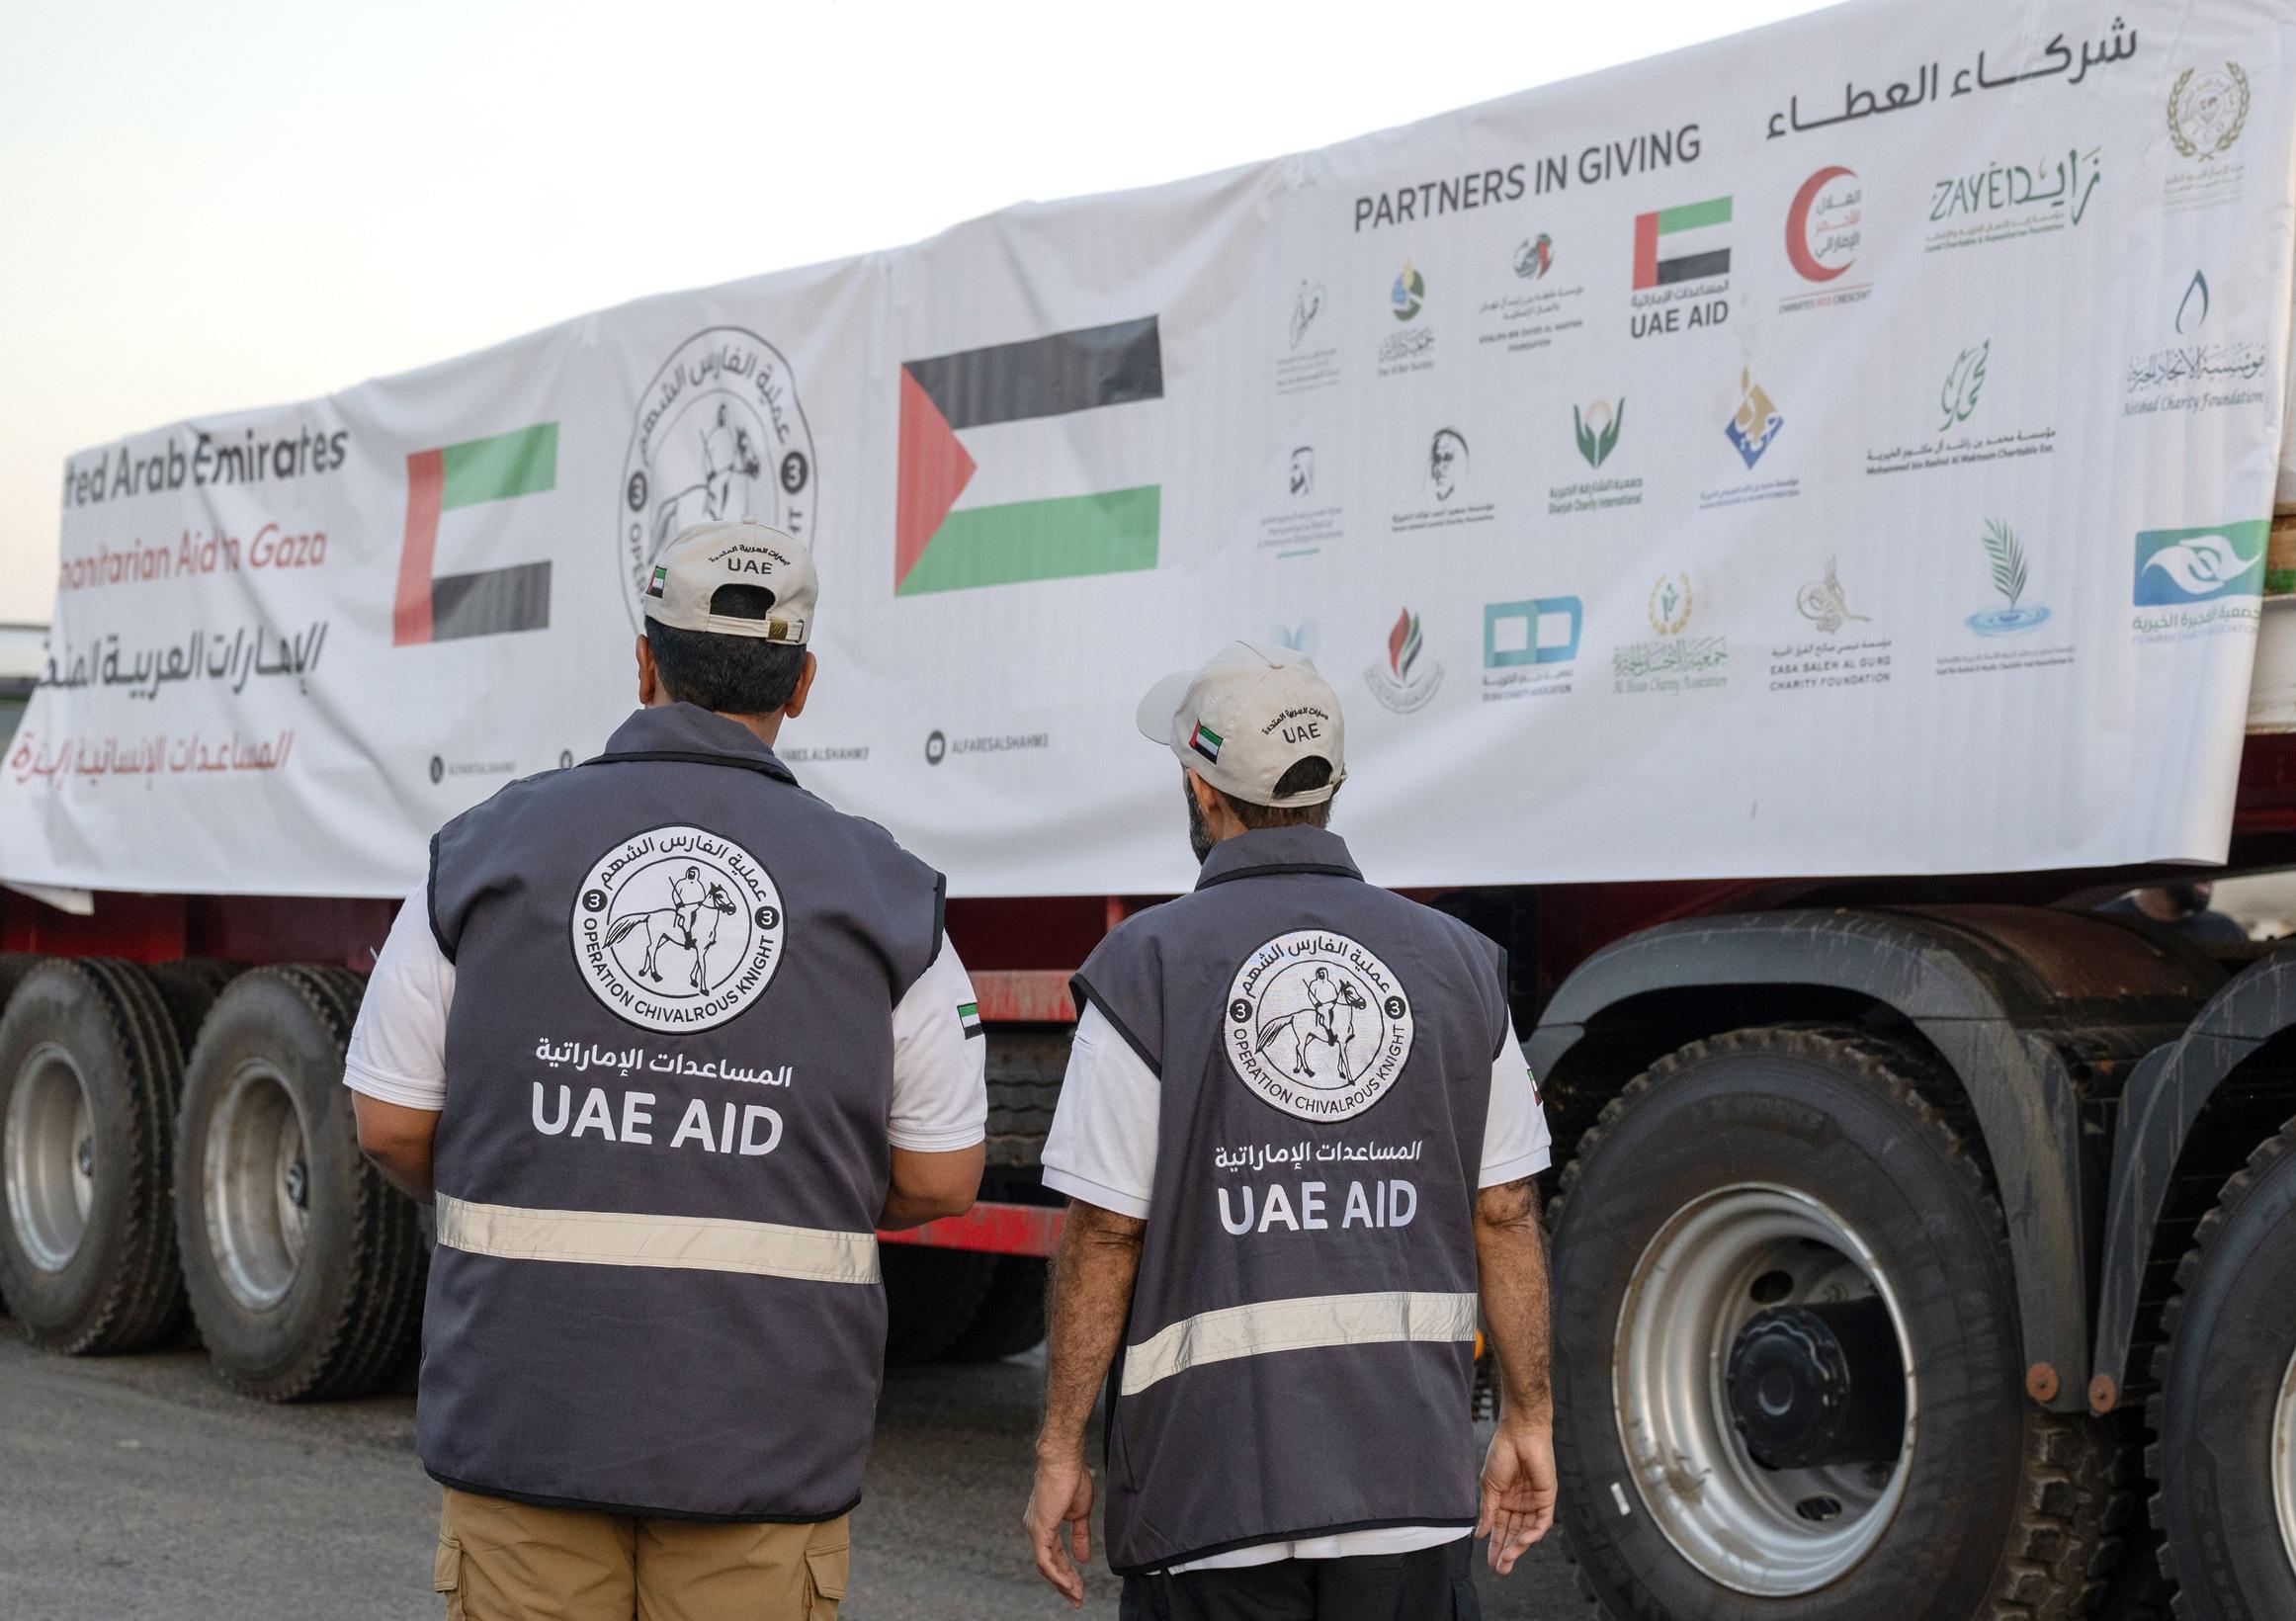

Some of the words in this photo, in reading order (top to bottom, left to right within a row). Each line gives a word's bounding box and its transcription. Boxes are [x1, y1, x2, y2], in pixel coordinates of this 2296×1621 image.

[1949, 17, 2138, 98] شركاء
[1766, 61, 1939, 140] العطاء
[1354, 164, 1526, 233] PARTNERS
[1535, 154, 1568, 196] IN
[1577, 124, 1701, 185] GIVING
[1674, 280, 1730, 300] المساعدات
[1631, 308, 1680, 339] UAE
[1687, 300, 1730, 330] AID
[690, 345, 758, 386] الفارس
[111, 439, 186, 498] Arab
[193, 425, 349, 486] Emirates
[250, 522, 327, 569] Gaza
[727, 557, 773, 575] UAE
[103, 631, 204, 700] العربية
[1769, 678, 1817, 692] CHARITY
[1820, 672, 1891, 688] FOUNDATION
[1803, 661, 1838, 674] SALEH
[1842, 659, 1855, 670] AL
[1282, 723, 1320, 743] UAE
[601, 836, 654, 891] الشهم
[659, 834, 729, 859] الفارس
[727, 853, 767, 902] عملية
[588, 894, 601, 908] 3
[761, 910, 773, 925] 3
[1288, 936, 1348, 957] الفارس
[583, 917, 635, 1007] OPERATION
[635, 989, 739, 1023] CHIVALROUS
[735, 934, 774, 995] KNIGHT
[1241, 943, 1284, 999] الشهم
[1350, 949, 1392, 994] عملية
[1235, 1003, 1246, 1019] 3
[1390, 1000, 1401, 1015] 3
[536, 1037, 643, 1077] الإماراتية
[649, 1053, 794, 1088] المساعدات
[1234, 1028, 1293, 1104] OPERATION
[1295, 1077, 1380, 1114] CHIVALROUS
[1376, 1024, 1404, 1080] KNIGHT
[532, 1081, 656, 1145] UAE
[670, 1098, 784, 1156] AID
[1215, 1142, 1312, 1172] الإماراتية
[1316, 1140, 1422, 1162] المساعدات
[1218, 1181, 1328, 1236] UAE
[1341, 1179, 1417, 1229] AID
